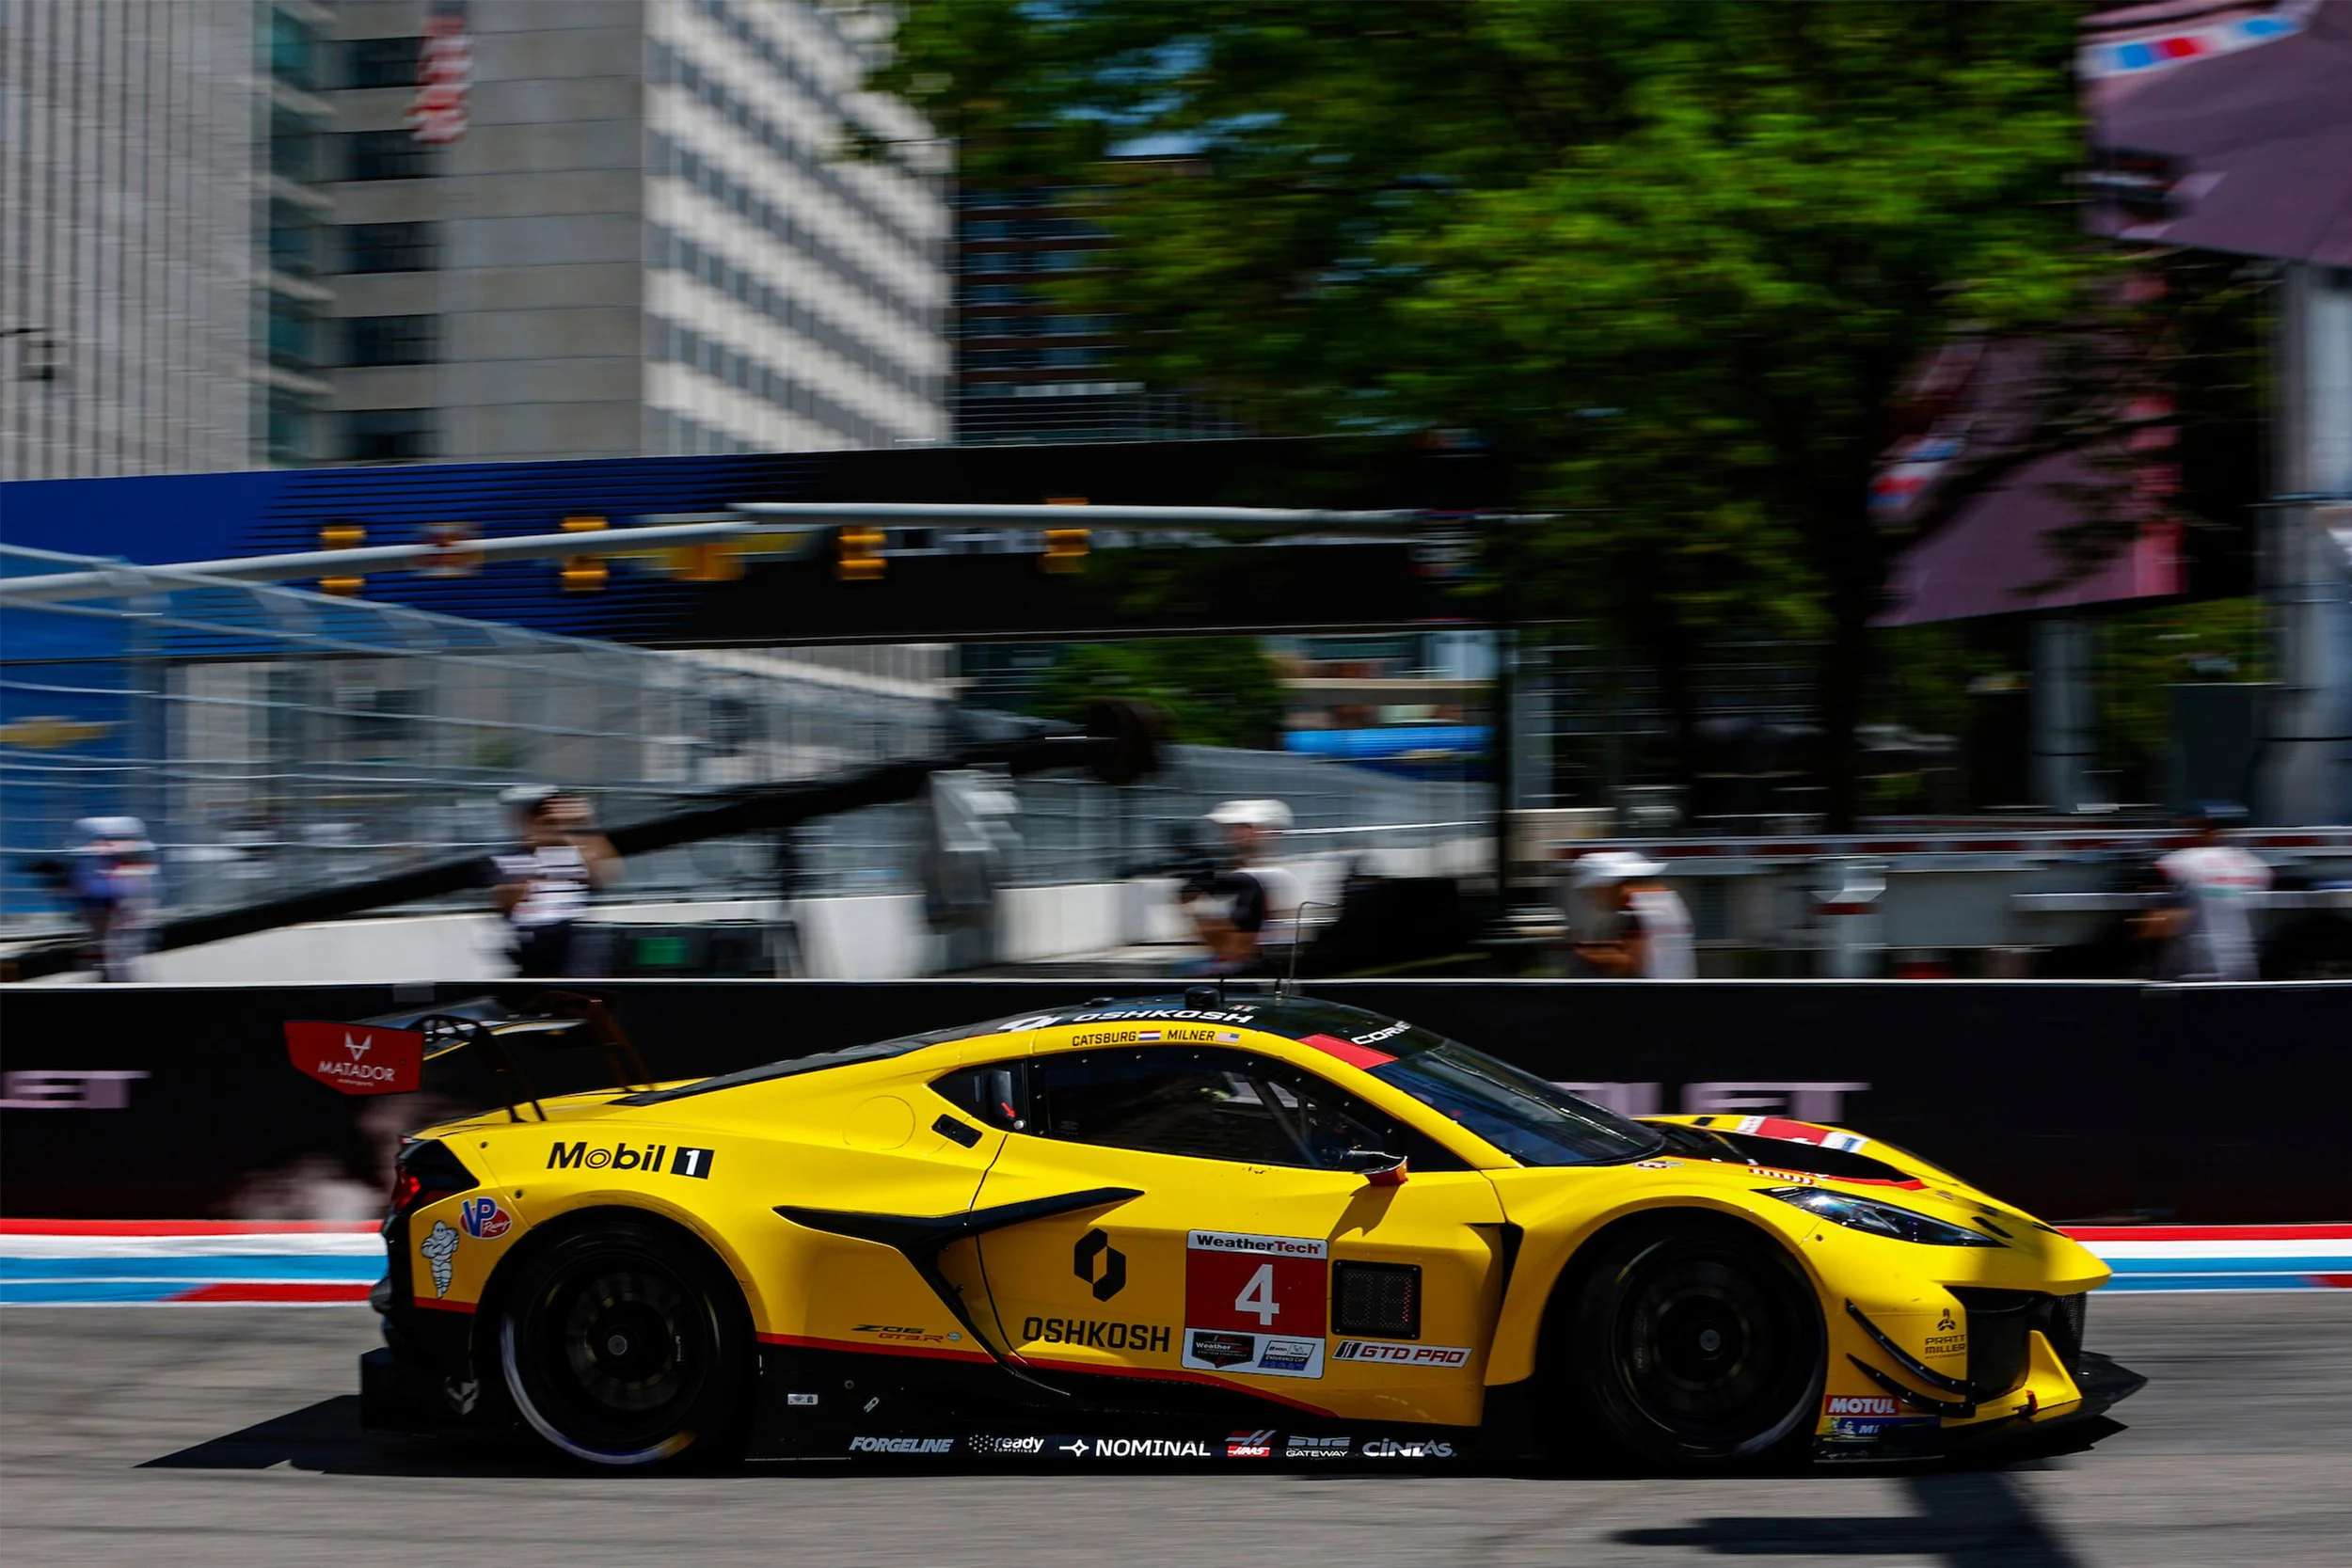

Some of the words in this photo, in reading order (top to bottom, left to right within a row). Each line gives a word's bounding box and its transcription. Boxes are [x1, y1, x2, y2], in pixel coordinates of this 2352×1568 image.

[1073, 1009, 1254, 1024] OSHKOSH
[1072, 1031, 1136, 1047] CATSBURG
[1167, 1030, 1216, 1042] MILNER
[318, 1061, 394, 1082] MATADOR
[547, 1141, 667, 1172] Mobil
[461, 1197, 497, 1238] VP
[1196, 1234, 1319, 1255] WeatherTech
[1235, 1263, 1280, 1326] 4
[1022, 1317, 1171, 1353] OSHKOSH
[1925, 1334, 1965, 1345] PRATT
[1359, 1345, 1411, 1360] GTD
[1413, 1349, 1466, 1364] PRO
[1925, 1343, 1965, 1354] MILLER
[1828, 1398, 1896, 1414] MOTUL
[849, 1436, 954, 1453] FORGELINE
[995, 1436, 1044, 1453] ready
[1095, 1439, 1212, 1457] NOMINAL
